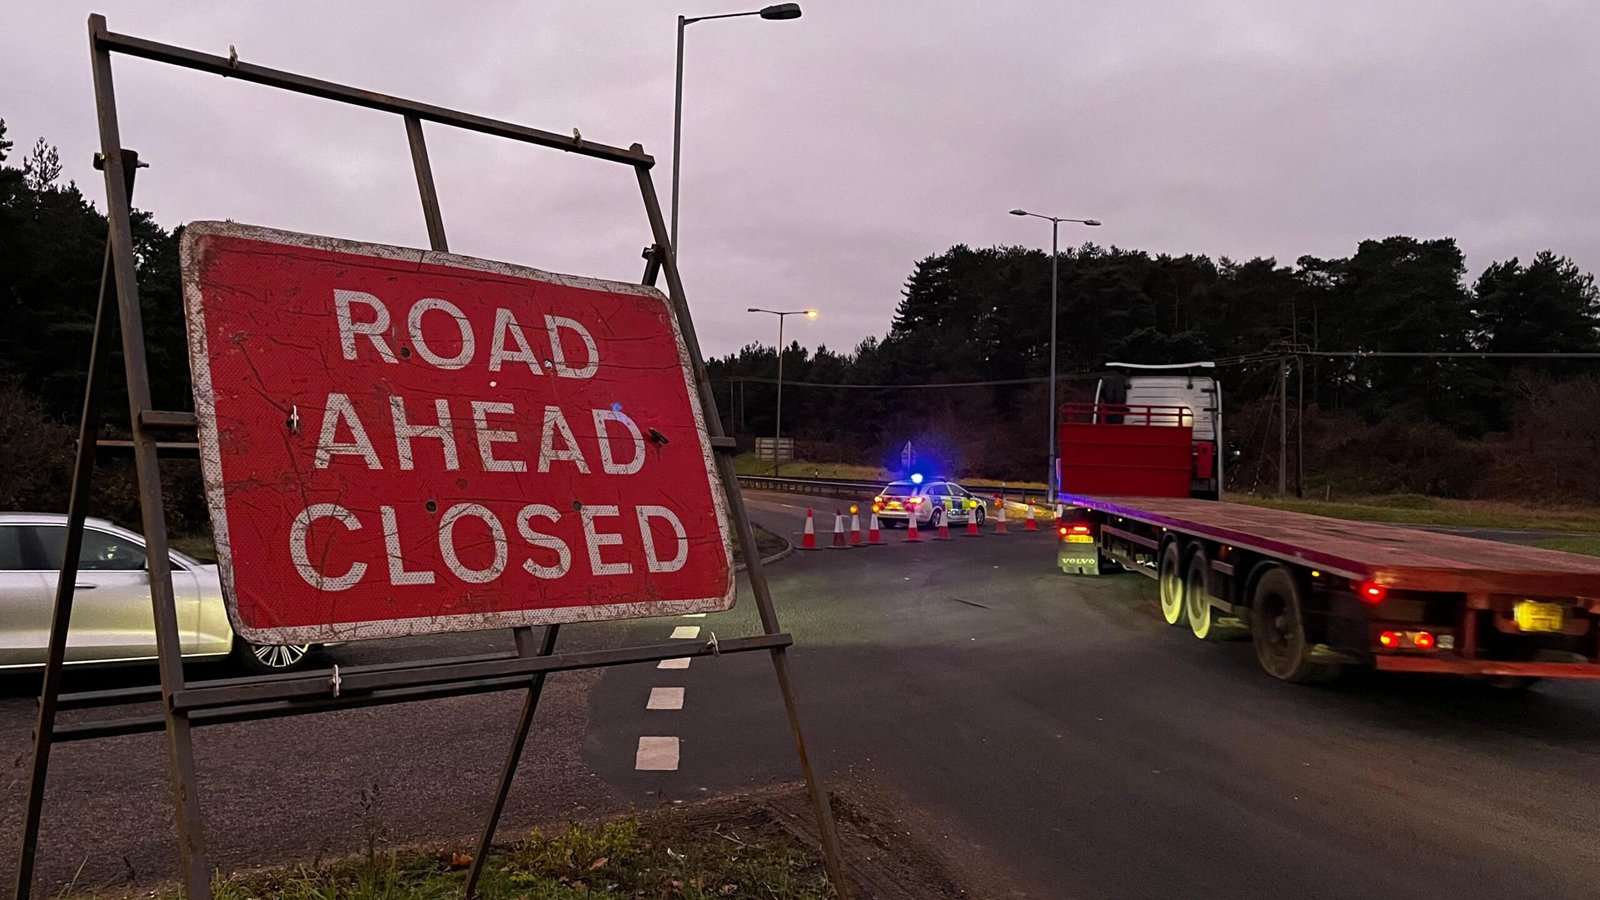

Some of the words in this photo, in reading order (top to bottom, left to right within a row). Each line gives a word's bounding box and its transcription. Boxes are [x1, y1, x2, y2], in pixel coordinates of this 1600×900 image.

[333, 288, 599, 379] ROAD
[313, 393, 646, 475] AHEAD
[289, 502, 689, 591] CLOSED
